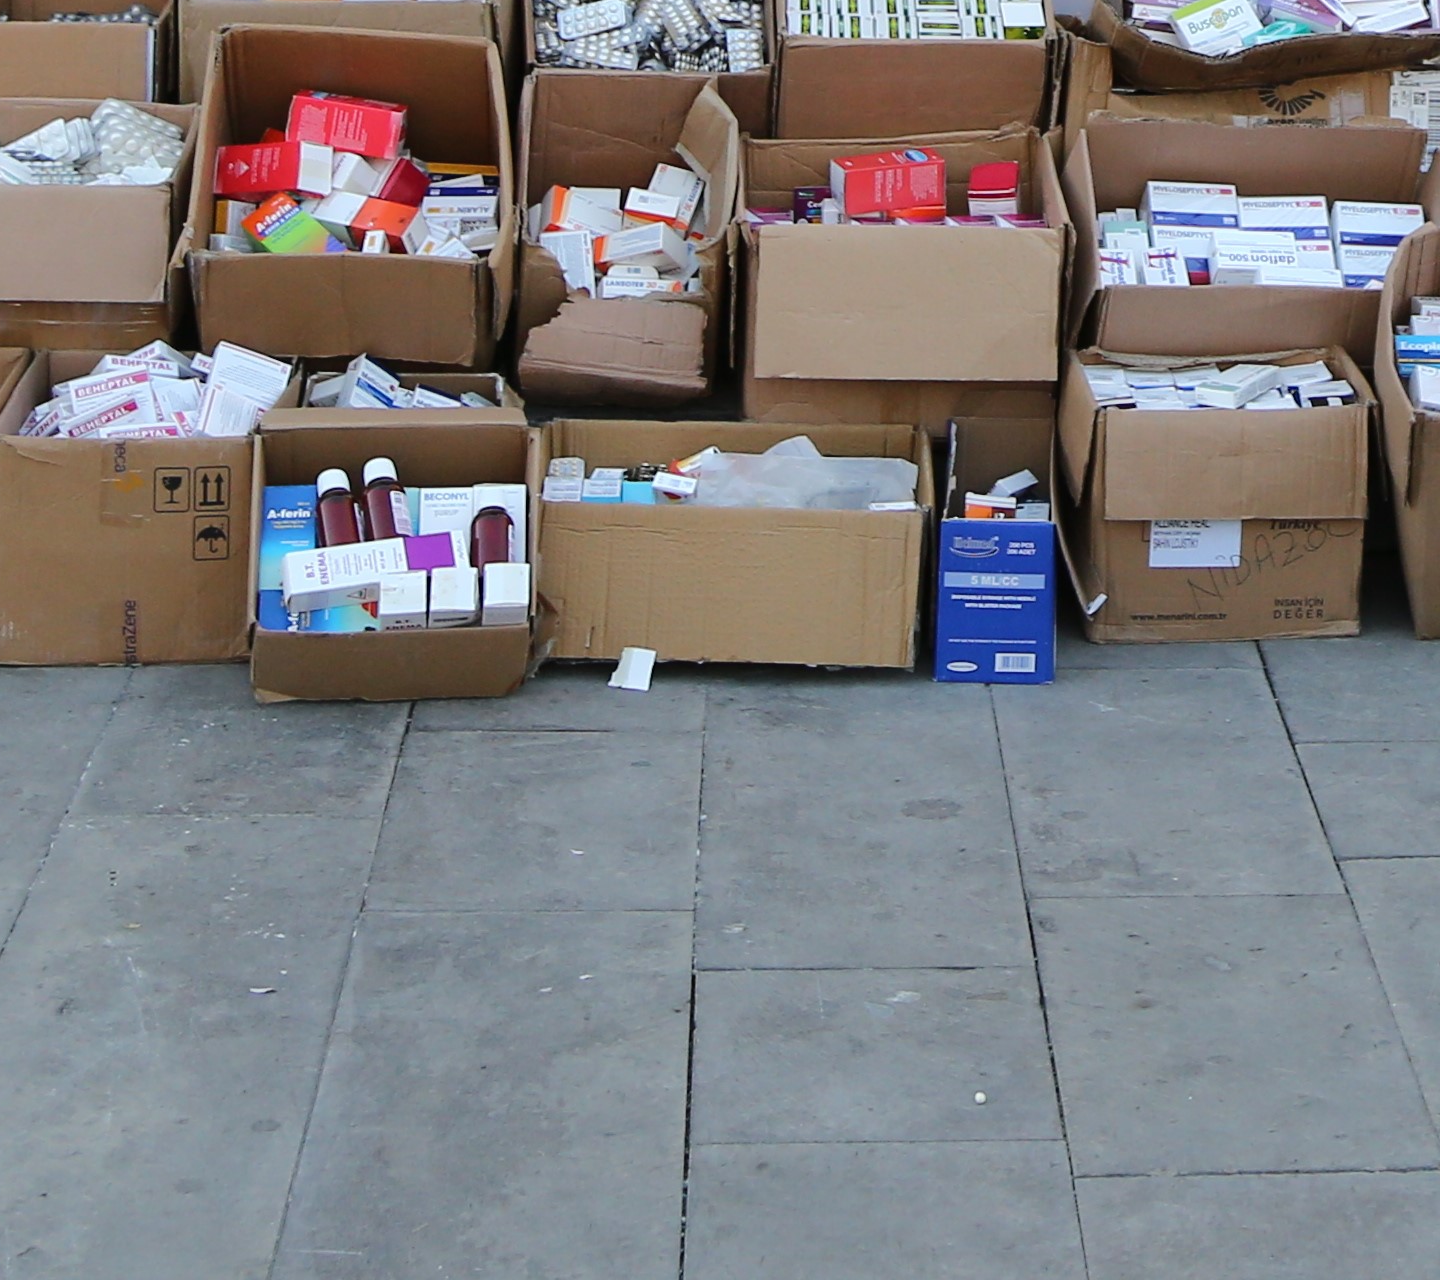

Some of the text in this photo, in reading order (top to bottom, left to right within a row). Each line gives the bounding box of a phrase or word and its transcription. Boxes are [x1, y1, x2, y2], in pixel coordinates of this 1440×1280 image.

[1188, 4, 1244, 36] Buscopan
[1229, 253, 1297, 266] daflon 500
[605, 279, 644, 288] LANSOTER
[77, 376, 136, 399] BEHEPTAL
[71, 404, 128, 438] BEHEPTAL
[424, 491, 470, 502] BECONYL
[266, 507, 312, 520] A-ferin
[305, 561, 316, 580] B.T.
[319, 551, 331, 586] ENEMA
[970, 575, 978, 586] 5
[1274, 606, 1325, 620] DEĞER
